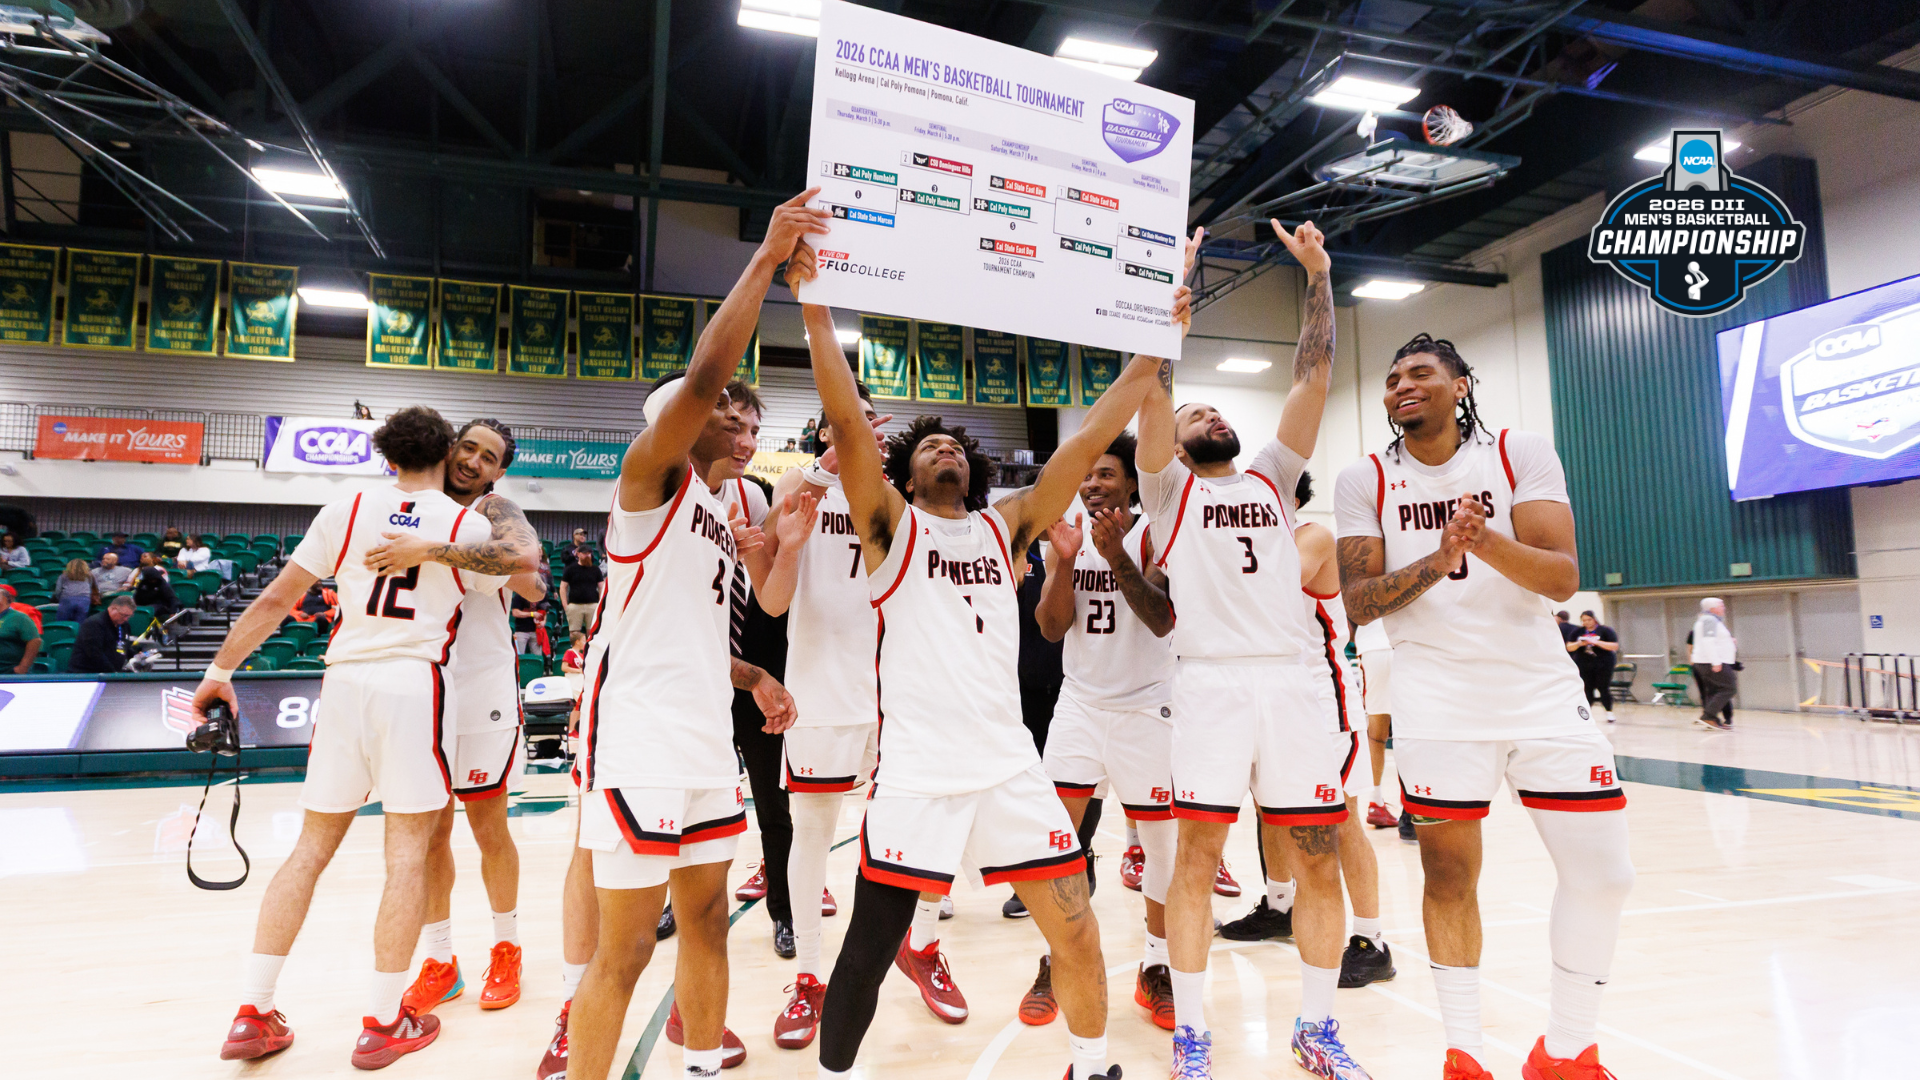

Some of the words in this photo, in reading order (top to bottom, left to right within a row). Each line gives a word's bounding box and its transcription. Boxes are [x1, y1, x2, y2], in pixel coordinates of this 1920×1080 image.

[834, 67, 857, 82] Kellogg
[858, 73, 875, 85] Arena
[880, 77, 890, 88] Cal
[890, 80, 903, 93] Poly
[904, 85, 926, 97] Pomona
[836, 39, 865, 63] 2026
[869, 47, 899, 72] CCAA
[904, 55, 940, 81] MEN'S
[944, 65, 1012, 99] BASKETBALL
[1016, 83, 1085, 118] TOURNAMENT
[1114, 100, 1134, 114] CCAA
[1106, 124, 1162, 140] BASKETBALL
[1115, 135, 1148, 148] TOURNAMENT
[930, 158, 938, 167] CSU
[852, 168, 860, 177] Cal
[861, 170, 872, 181] Poly
[873, 172, 895, 184] Humboldt
[1014, 182, 1024, 192] State
[1025, 185, 1035, 194] East
[1035, 187, 1044, 197] Bay
[926, 195, 936, 206] Poly
[849, 210, 857, 218] Cal
[857, 211, 868, 221] State
[869, 214, 877, 222] San
[998, 204, 1007, 214] Poly
[822, 250, 835, 258] LIVE
[1004, 243, 1015, 253] State
[1015, 246, 1025, 255] East
[1082, 244, 1092, 255] Poly
[983, 263, 1012, 275] TOURNAMENT
[1011, 259, 1022, 268] CCAA
[64, 432, 107, 444] MAKE
[109, 434, 125, 444] IT
[127, 427, 187, 451] YOURS
[299, 430, 367, 457] CCAA
[305, 453, 359, 463] CHAMPIONSHIPS
[517, 453, 554, 464] MAKE
[555, 454, 568, 464] IT
[568, 448, 618, 470] YOURS
[751, 465, 783, 474] MAKE
[1398, 490, 1495, 531] PIONES
[389, 513, 421, 529] CCAA
[821, 511, 859, 536] PION
[691, 502, 735, 565] PIONEE
[848, 543, 862, 579] 7
[1236, 536, 1259, 574] 3
[366, 562, 421, 621] 12
[1086, 599, 1116, 635] 23
[467, 769, 489, 786] EB
[1589, 765, 1615, 788] EB
[1150, 786, 1171, 804] EB
[1314, 783, 1337, 804] EB
[1049, 829, 1073, 853] EB
